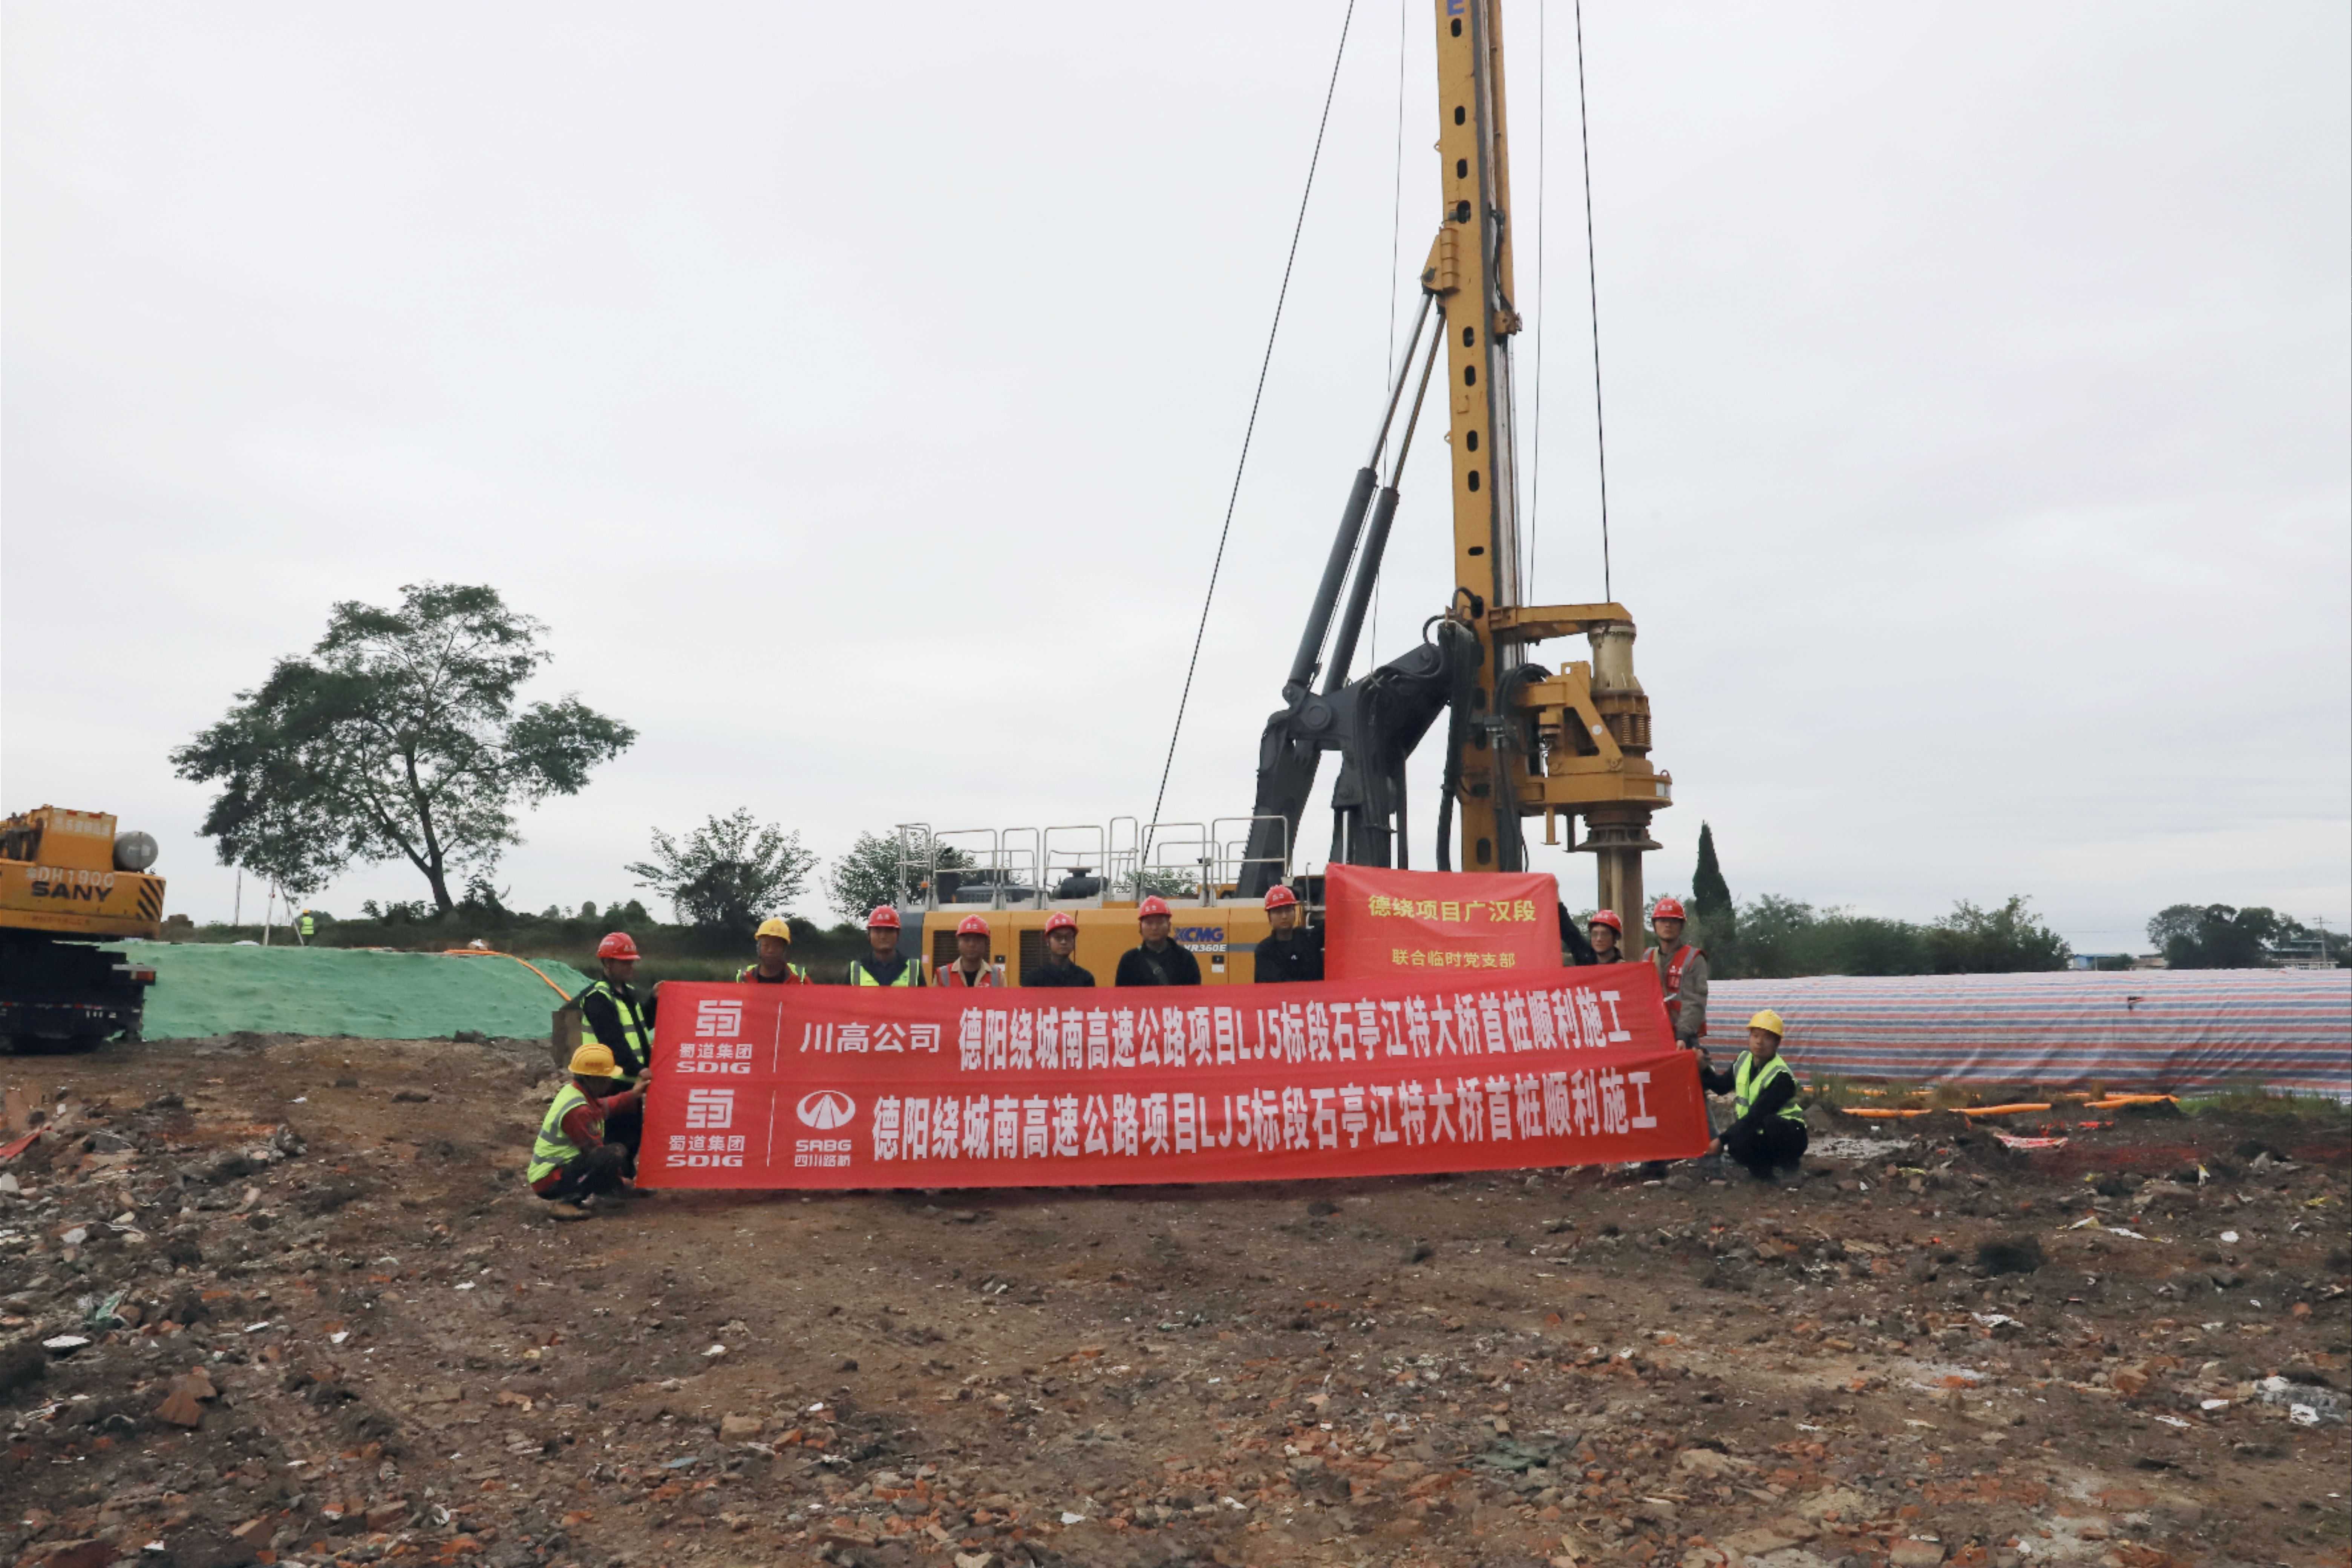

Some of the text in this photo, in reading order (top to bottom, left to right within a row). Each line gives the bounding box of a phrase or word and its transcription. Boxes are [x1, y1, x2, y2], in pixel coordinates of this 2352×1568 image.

[31, 880, 113, 902] SANY
[1368, 894, 1536, 922] 德绕项目广汉段
[1174, 927, 1224, 942] XCMG
[1392, 949, 1516, 968] 联合临时党支部
[800, 1022, 941, 1053] 川高公司
[959, 986, 1632, 1071] 德阳绕城南高速公路项目LJ5标段石亭江特大桥首桩顺利施工
[679, 1043, 752, 1059] 蜀道集团
[676, 1061, 750, 1074] SDIG
[872, 1067, 1657, 1161] 德阳绕城南高速公路项目LJ5标段石亭江特大桥首桩顺利施工
[669, 1135, 745, 1152] 蜀道集团
[666, 1155, 743, 1167] SDIG
[795, 1154, 850, 1167] 四川路桥
